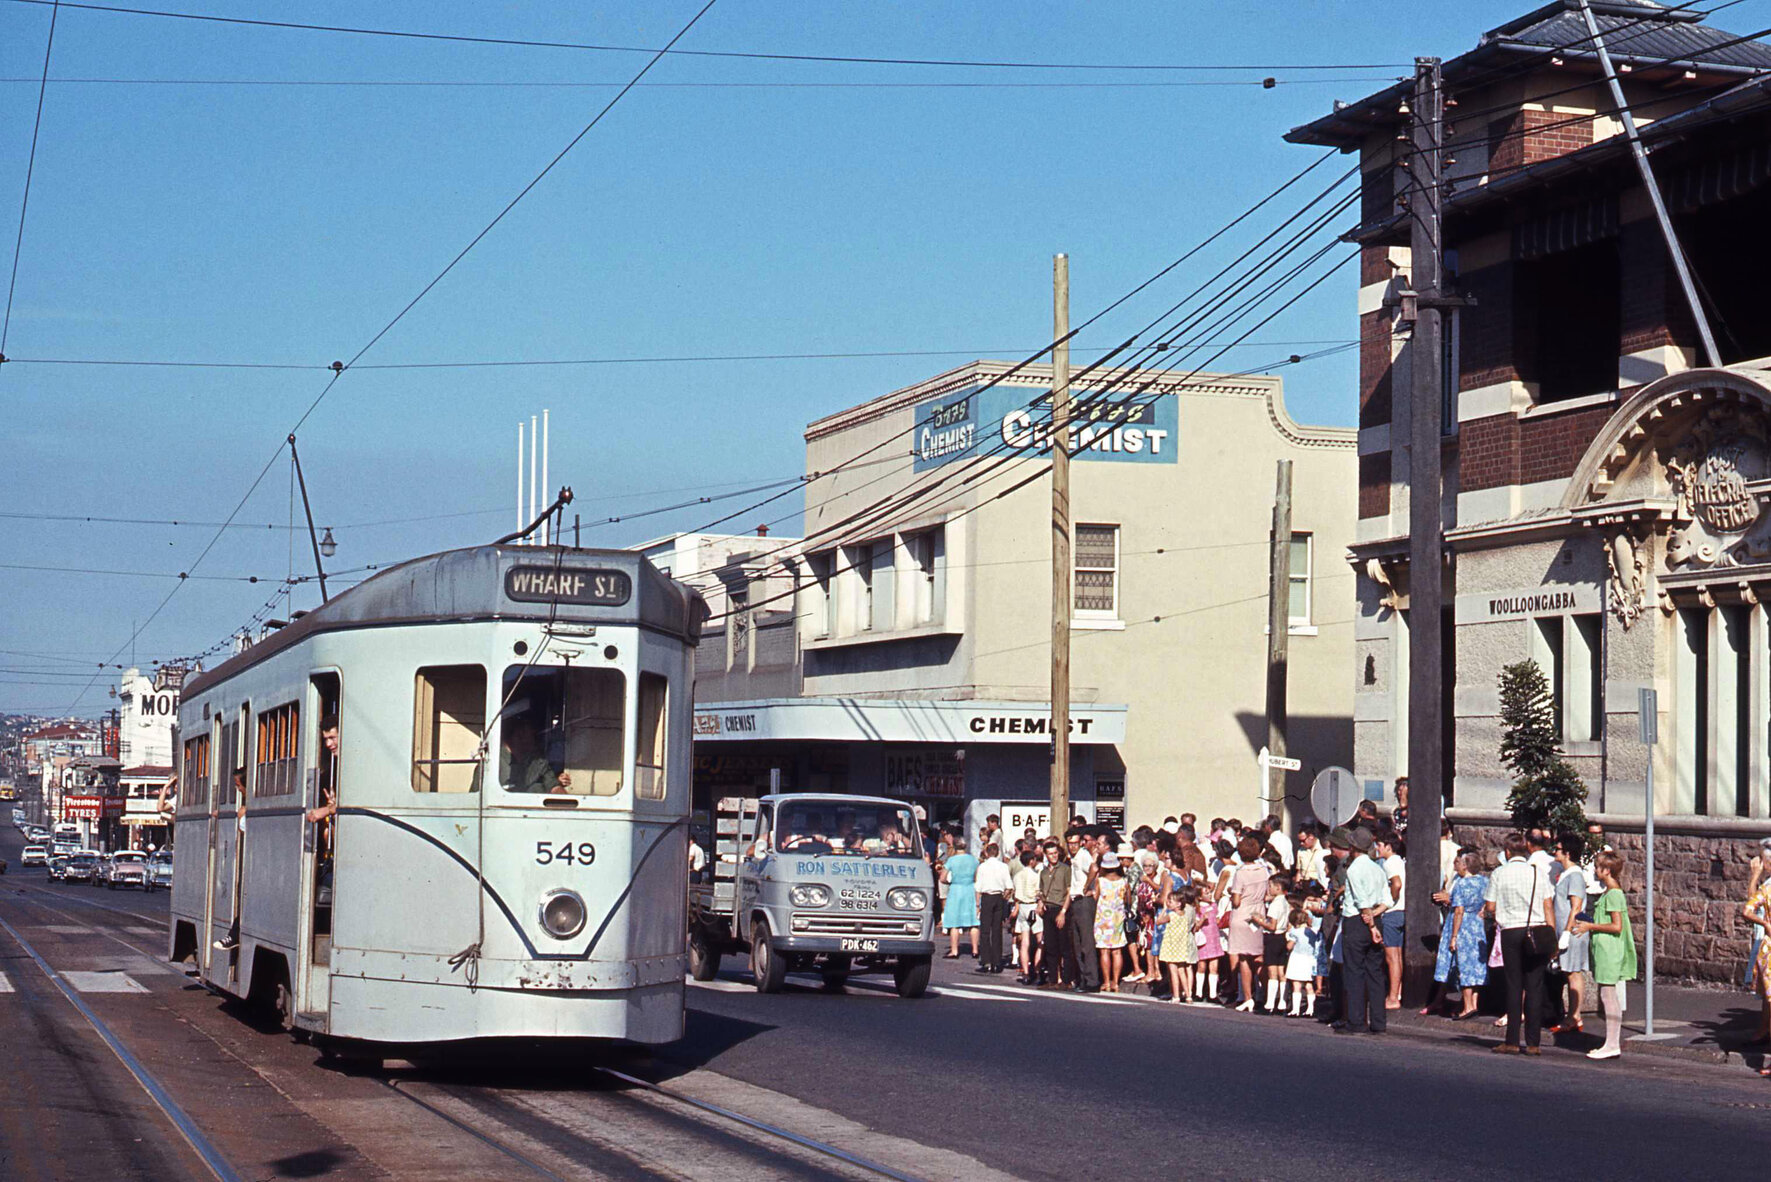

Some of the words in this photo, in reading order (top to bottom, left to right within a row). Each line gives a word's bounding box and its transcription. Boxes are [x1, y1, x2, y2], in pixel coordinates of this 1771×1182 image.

[921, 423, 975, 461] CHEMIST
[1707, 501, 1749, 528] OFFICE
[513, 573, 585, 596] WHARF
[1489, 592, 1576, 615] WOOLLOONGABBA
[725, 714, 757, 733] CHEMIST
[68, 808, 97, 818] TYRES
[536, 841, 596, 866] 549
[797, 861, 825, 875] RON
[831, 861, 917, 879] SATTERLEY
[840, 889, 854, 898] 62
[857, 890, 881, 899] 1224
[840, 900, 854, 909] 98
[856, 901, 879, 910] 6314
